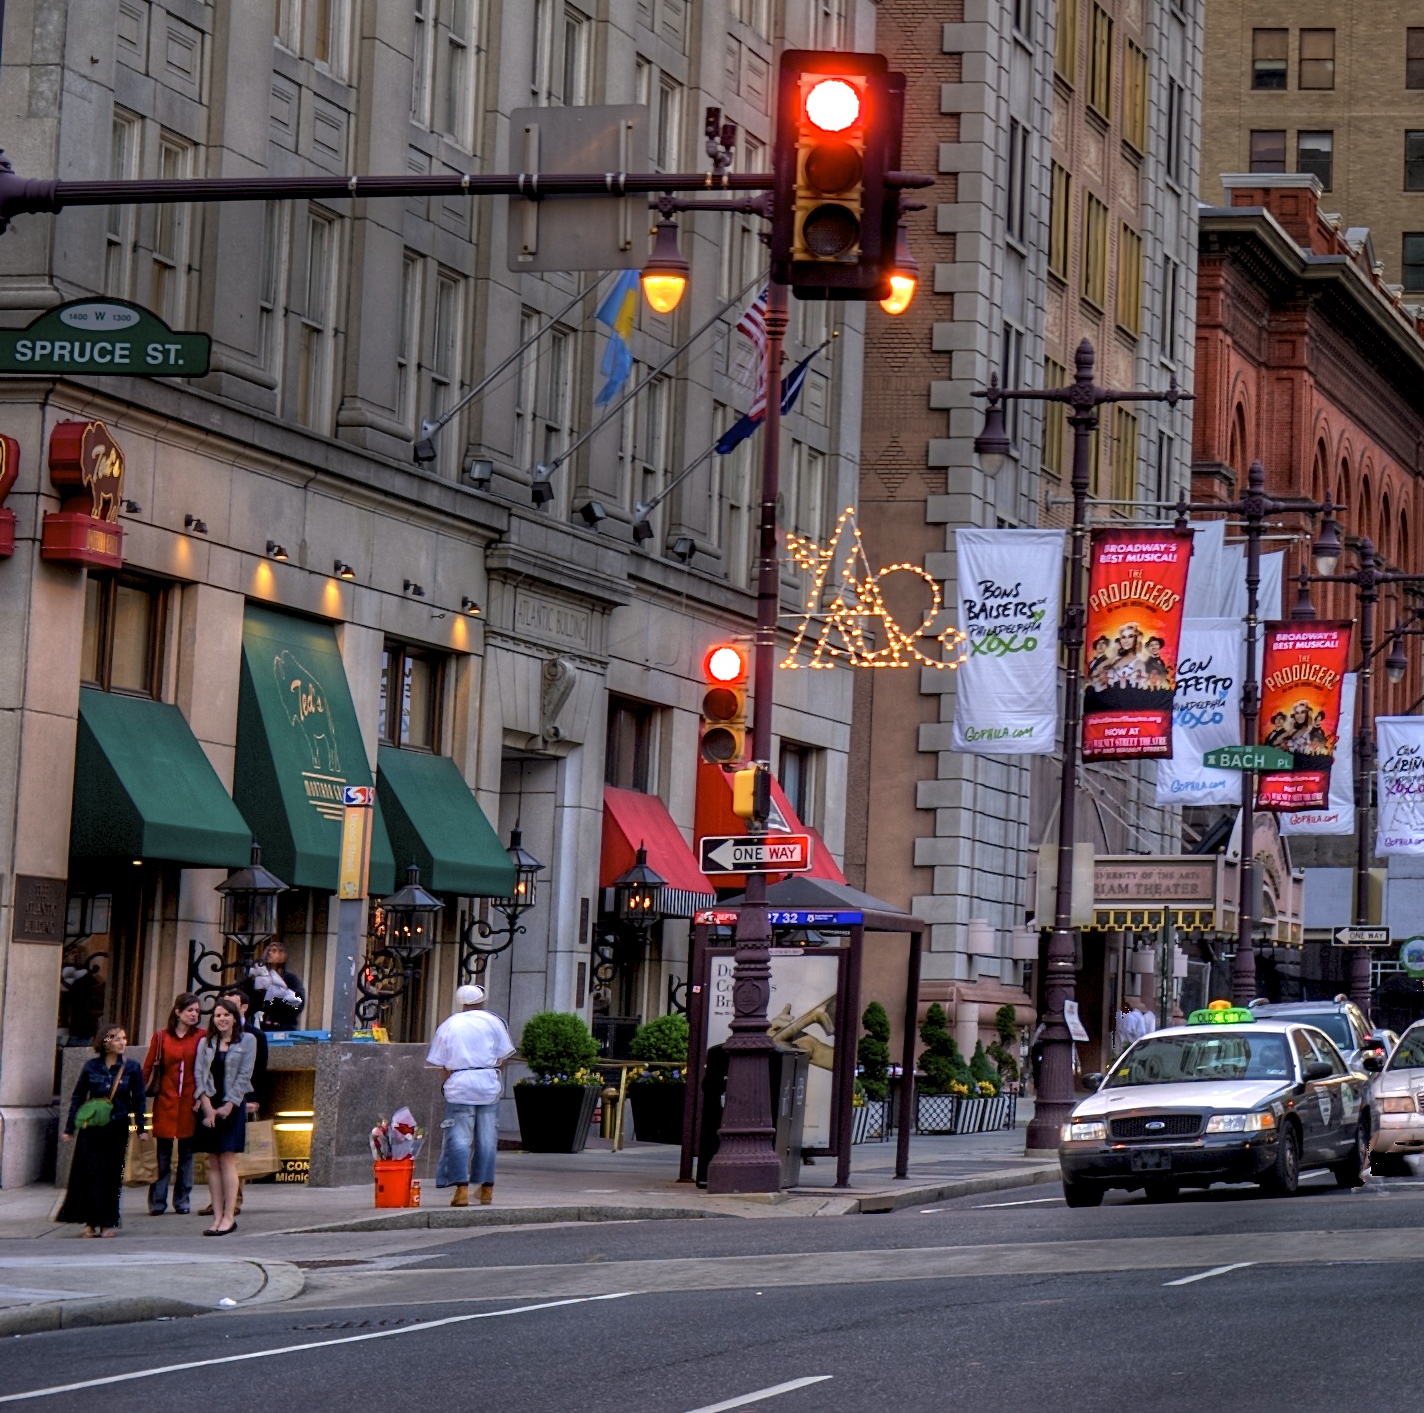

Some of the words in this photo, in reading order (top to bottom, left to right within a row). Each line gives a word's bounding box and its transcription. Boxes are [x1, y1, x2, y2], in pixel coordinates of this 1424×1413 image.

[69, 313, 88, 321] 1400
[95, 311, 106, 321] W
[112, 314, 131, 322] 1300
[15, 340, 131, 364] SPRUCE
[146, 343, 184, 365] ST.
[1103, 543, 1177, 554] BROADWAY'S
[1099, 554, 1124, 564] BEST
[1128, 569, 1143, 578] THE
[978, 579, 1022, 600] BONS
[1089, 579, 1180, 612] PRODUCERS
[963, 599, 1037, 621] BAISERS
[1276, 632, 1338, 641] BROADWAY'S
[969, 634, 1038, 657] XOXO
[1272, 642, 1294, 650] BEST
[1177, 656, 1213, 676] CON
[290, 678, 323, 721] Ted's
[1104, 728, 1127, 737] NOW
[1128, 727, 1140, 736] AT
[1220, 754, 1265, 767] BACH
[1277, 758, 1290, 767] PL
[733, 847, 764, 861] ONE
[769, 846, 797, 860] WAY
[1141, 871, 1154, 880] OF
[1157, 871, 1174, 880] THE
[1094, 883, 1129, 895] RIAM
[1134, 883, 1200, 895] THEATER
[782, 913, 798, 924] 32
[1349, 930, 1365, 939] ONE
[1368, 930, 1385, 939] WAY
